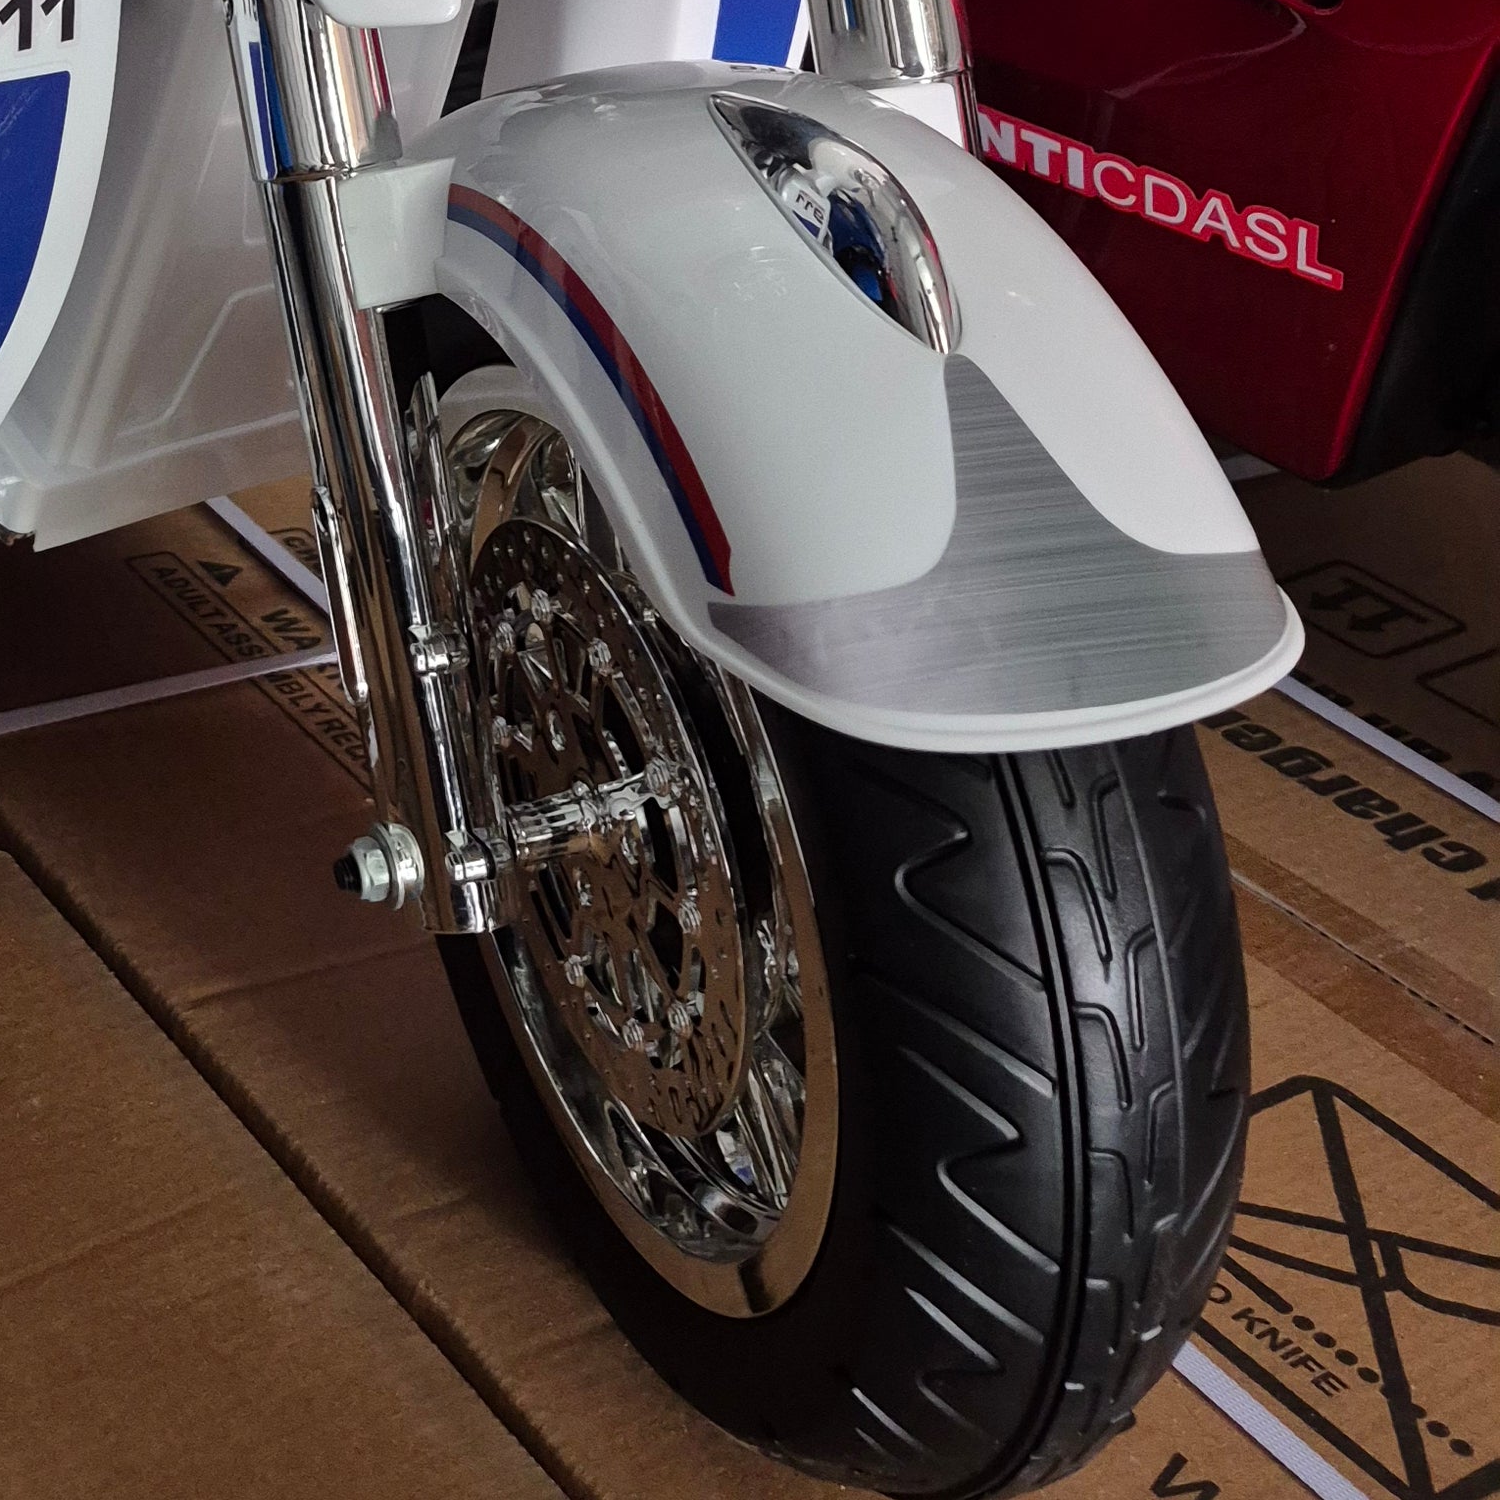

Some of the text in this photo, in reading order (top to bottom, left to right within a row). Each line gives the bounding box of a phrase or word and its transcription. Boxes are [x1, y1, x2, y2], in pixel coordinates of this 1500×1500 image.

[978, 112, 1333, 281] NTICDASL
[151, 567, 222, 616] ADULT
[1231, 1309, 1350, 1398] KNIFE
